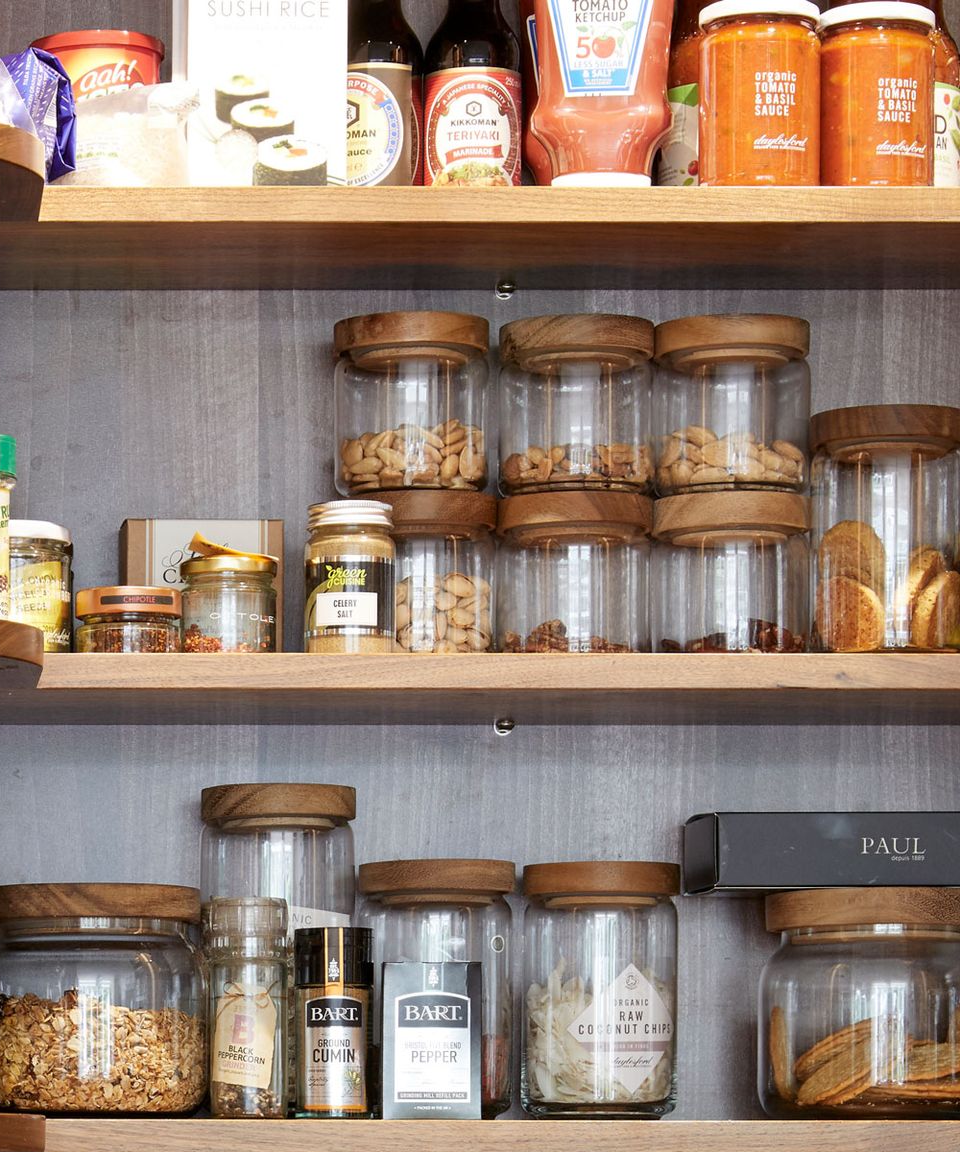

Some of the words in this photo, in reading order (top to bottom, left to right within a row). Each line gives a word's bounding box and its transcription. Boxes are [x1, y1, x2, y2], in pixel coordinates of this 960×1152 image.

[207, 0, 270, 17] SUSHI
[280, 0, 329, 18] RICE
[573, 0, 628, 11] TOMATO
[575, 12, 626, 22] KETCHUP
[755, 71, 797, 82] organic
[755, 82, 795, 94] TOMATO
[878, 77, 917, 89] organic
[755, 94, 763, 104] &
[765, 94, 795, 106] BASIL
[878, 88, 917, 101] TOMATO
[755, 105, 789, 116] SAUCE
[878, 100, 885, 109] &
[888, 100, 917, 112] BASIL
[451, 119, 497, 127] KIKKOMAN
[877, 111, 911, 123] SAUCE
[448, 131, 500, 142] TERIYAKI
[327, 566, 367, 589] green
[333, 578, 366, 586] CUISINE
[123, 596, 156, 604] CHIPOTLE
[333, 600, 357, 608] CELERY
[337, 610, 352, 618] SALT
[861, 837, 927, 854] PAUL
[620, 1011, 644, 1021] RAW
[578, 1023, 638, 1035] COCONUT
[644, 1023, 671, 1034] CHIPS
[318, 1039, 351, 1048] GROUND
[443, 1041, 462, 1050] BLEND
[228, 1044, 254, 1056] BLACK
[313, 1048, 356, 1063] CUMIN
[217, 1050, 266, 1065] PEPPERCORN
[411, 1050, 457, 1063] PEPPER
